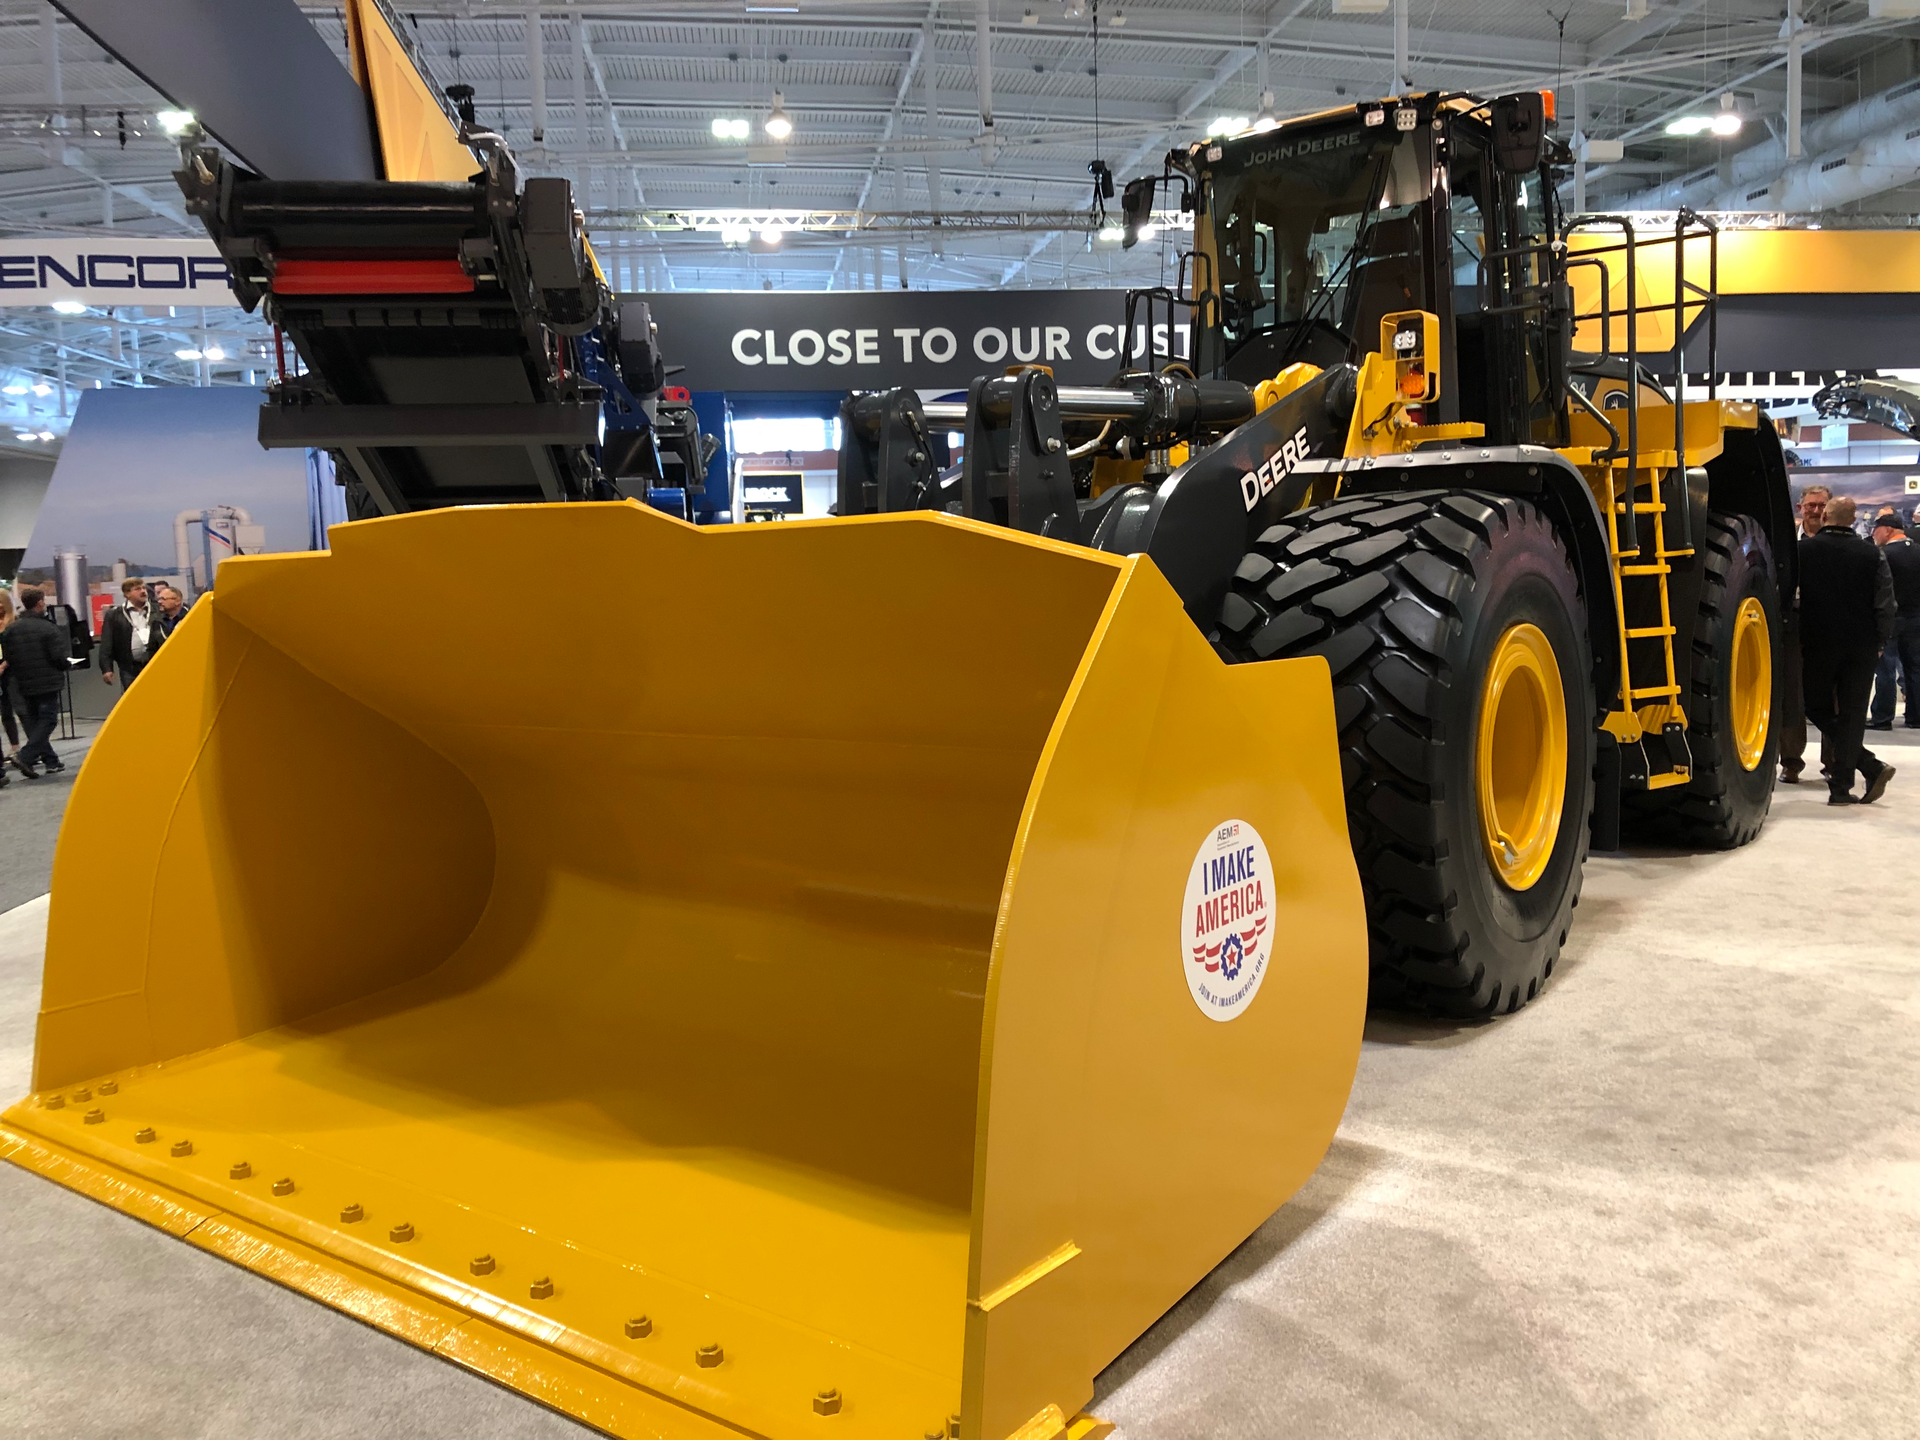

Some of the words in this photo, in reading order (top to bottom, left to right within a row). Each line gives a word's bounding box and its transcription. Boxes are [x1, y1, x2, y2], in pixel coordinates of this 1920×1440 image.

[1244, 145, 1293, 168] JOHN
[1297, 131, 1361, 156] DEERE
[731, 328, 881, 366] CLOSE
[893, 327, 958, 364] TO
[973, 326, 1072, 363] OUR
[1240, 425, 1311, 513] DEERE
[1216, 825, 1233, 843] AEM
[1203, 862, 1208, 895] I
[1211, 845, 1255, 892] MAKE
[1195, 880, 1265, 938] AMERICA
[1198, 982, 1210, 1002] JOIN
[1210, 994, 1218, 1006] AT
